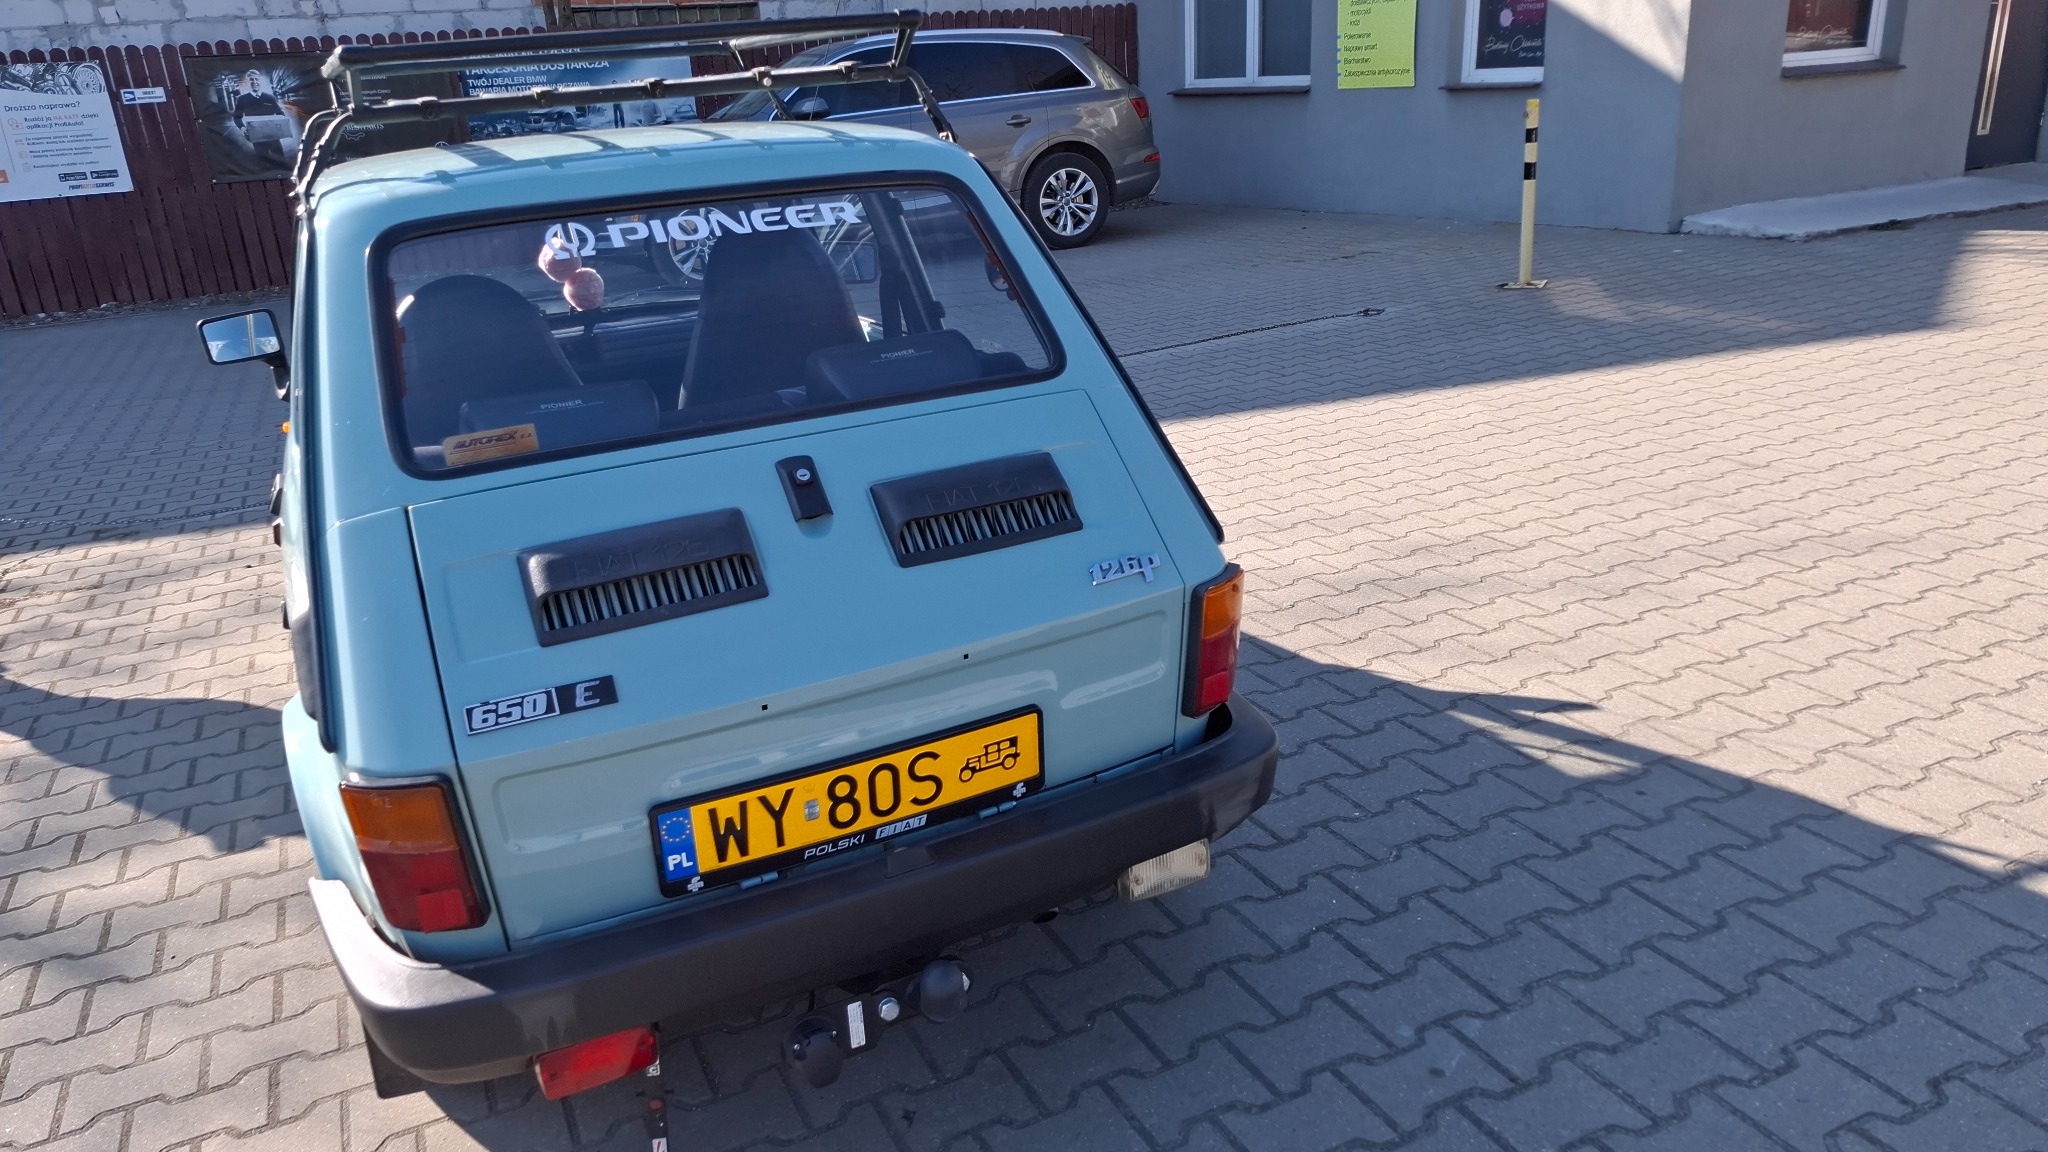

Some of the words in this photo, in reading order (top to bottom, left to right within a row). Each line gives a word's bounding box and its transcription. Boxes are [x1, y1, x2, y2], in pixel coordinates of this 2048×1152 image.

[467, 77, 492, 87] TWÓJ
[493, 76, 526, 86] DEALER
[526, 75, 547, 84] BMW
[469, 85, 506, 96] BAWARIA
[4, 104, 37, 112] Droższa
[38, 101, 81, 110] naprawa?
[607, 202, 863, 249] PIONEER
[541, 399, 583, 410] PIONIER
[1090, 553, 1161, 586] 126p
[471, 693, 548, 730] 650
[575, 680, 601, 708] E
[708, 787, 795, 864] WY
[827, 750, 943, 830] 80S
[804, 833, 865, 860] POLSKI
[876, 813, 928, 840] FIAT
[667, 851, 694, 871] PL
